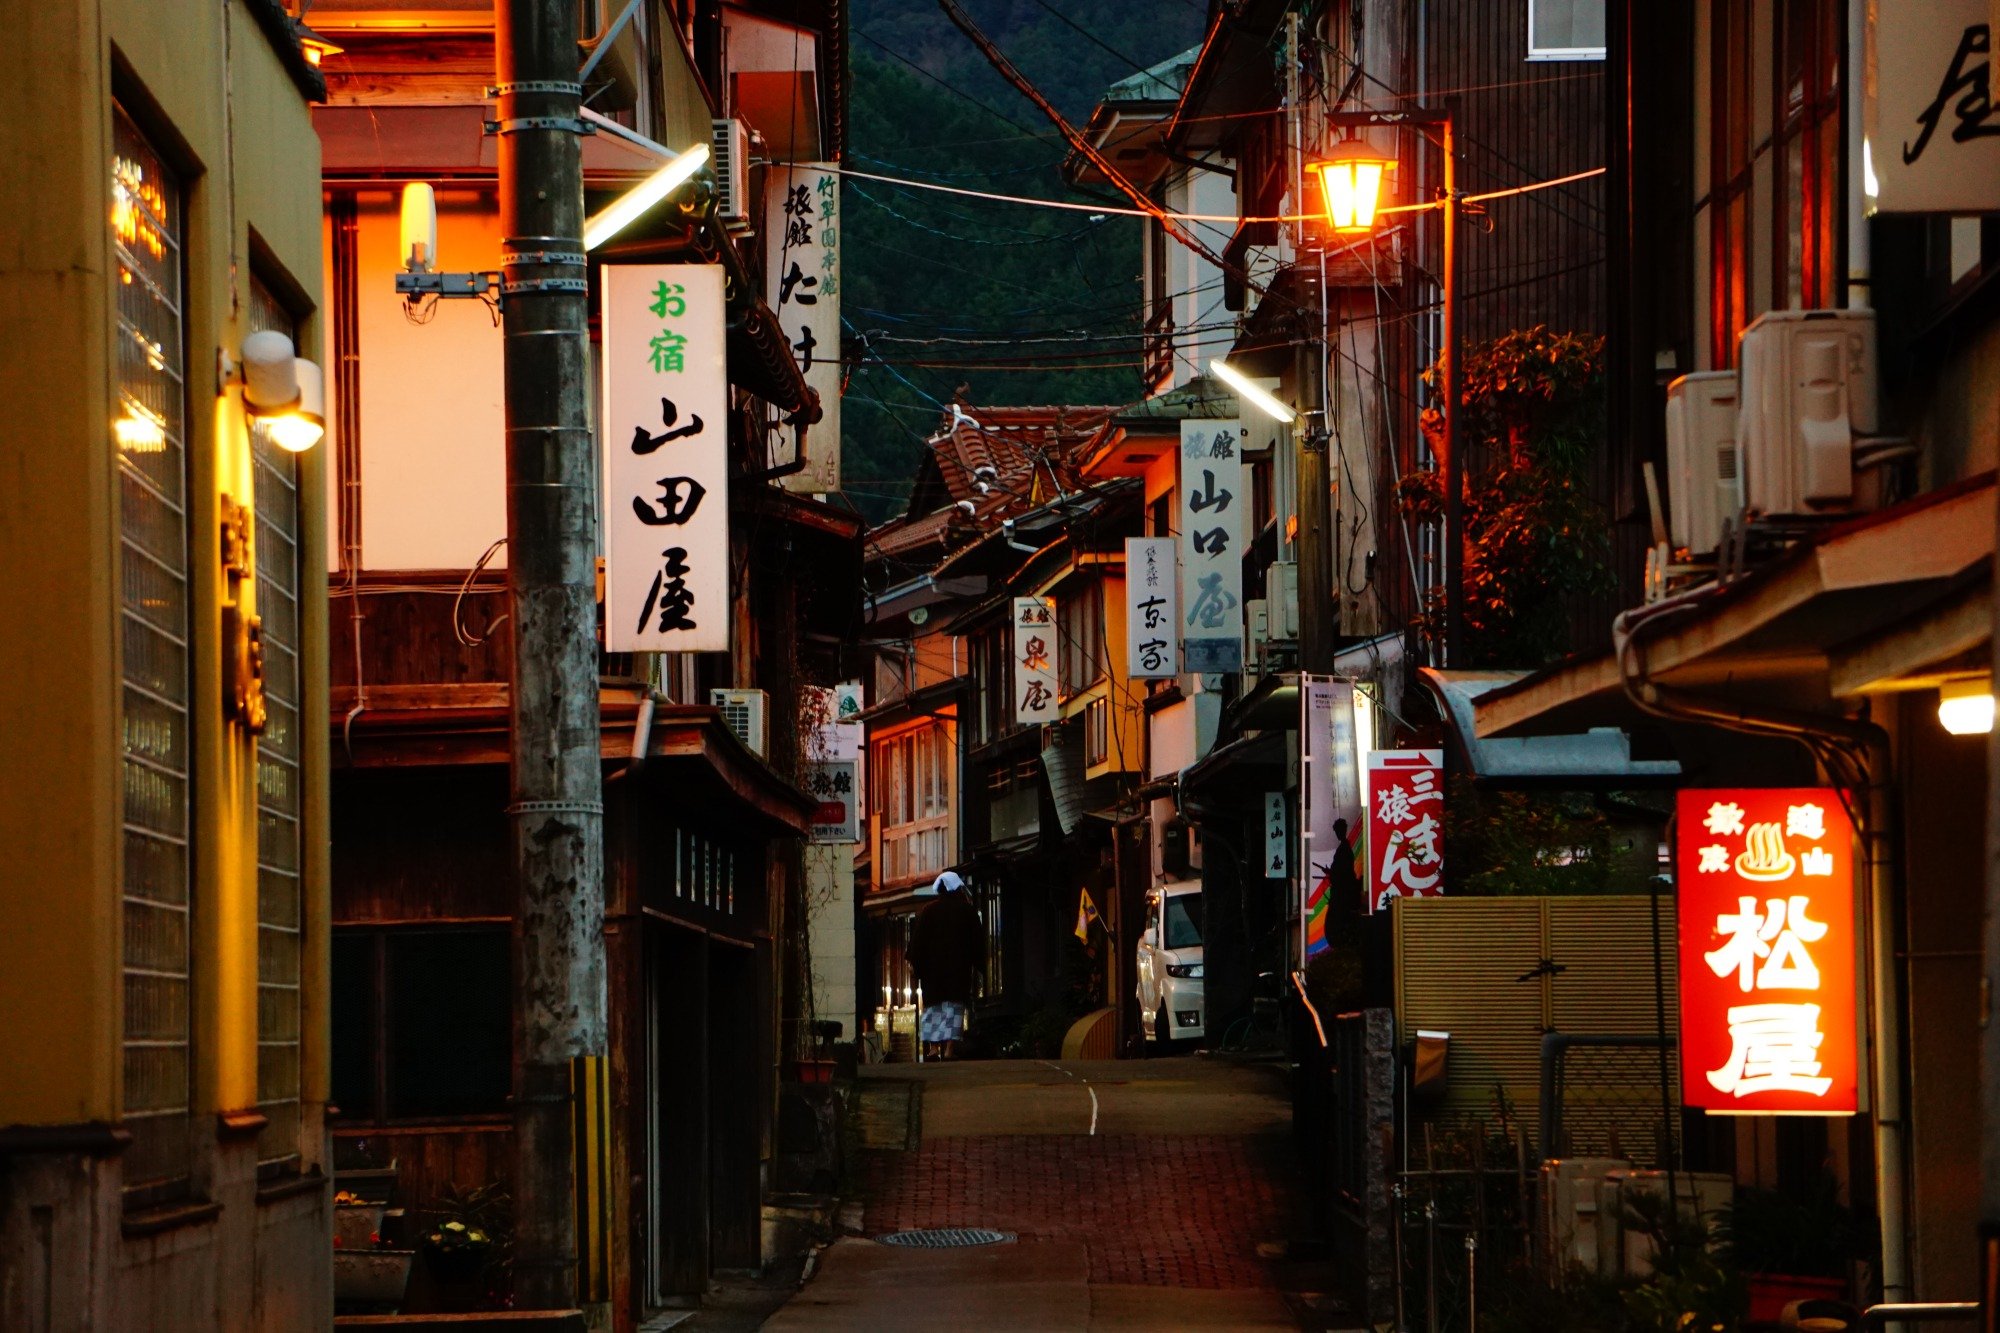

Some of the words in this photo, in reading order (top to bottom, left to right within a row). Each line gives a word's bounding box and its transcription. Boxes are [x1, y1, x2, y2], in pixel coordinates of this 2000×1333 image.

[648, 280, 688, 374] お宿
[1184, 430, 1236, 459] 旅館
[631, 397, 706, 635] 山田屋
[1187, 469, 1237, 628] 山口屋
[1021, 635, 1052, 711] 泉屋
[1704, 896, 1833, 1098] 松屋
